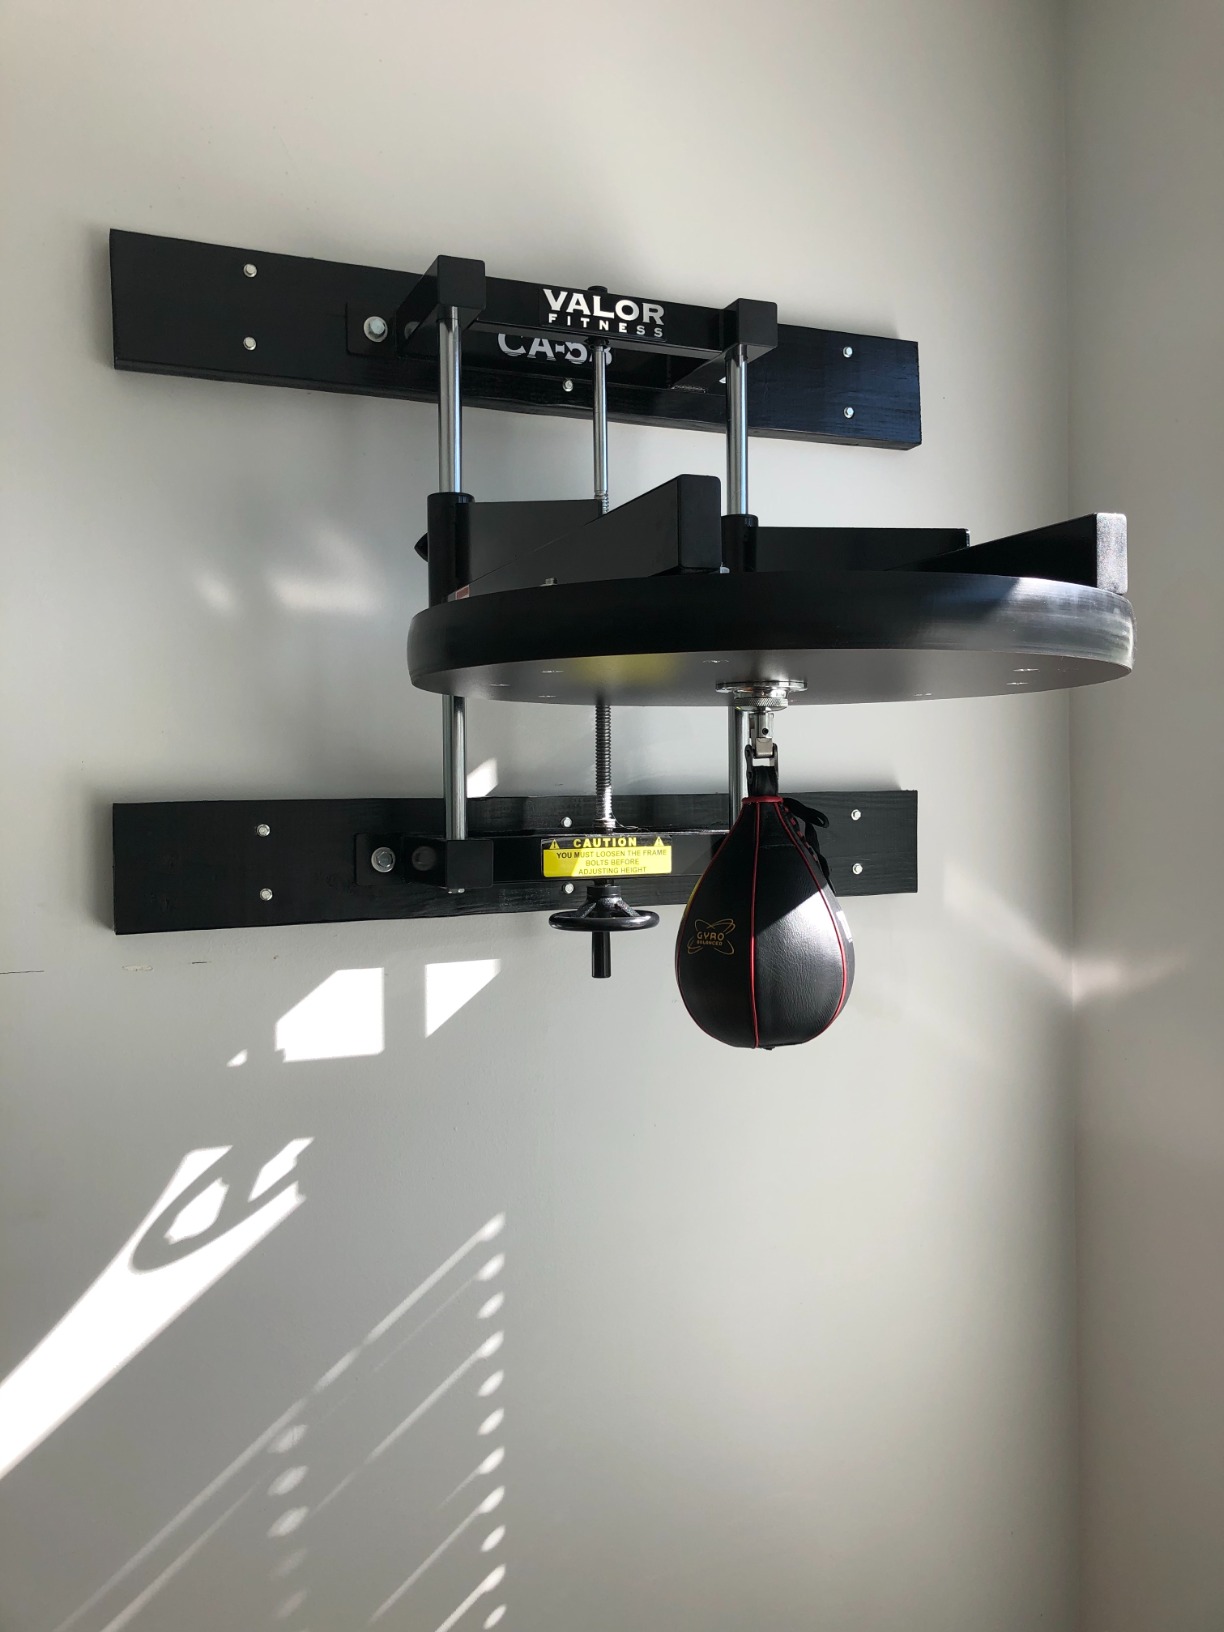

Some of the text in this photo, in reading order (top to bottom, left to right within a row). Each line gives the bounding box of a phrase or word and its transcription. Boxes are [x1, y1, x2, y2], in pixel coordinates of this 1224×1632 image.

[543, 288, 665, 325] VALOR
[548, 313, 663, 338] FITNESS
[573, 836, 637, 848] CAUTION
[556, 848, 667, 859] YOU MUST LOOSEN THE FRAME
[585, 858, 640, 867] BOLTS BEFORE
[578, 866, 647, 875] ADJUSTING HEIGHT
[696, 931, 725, 941] GYRO
